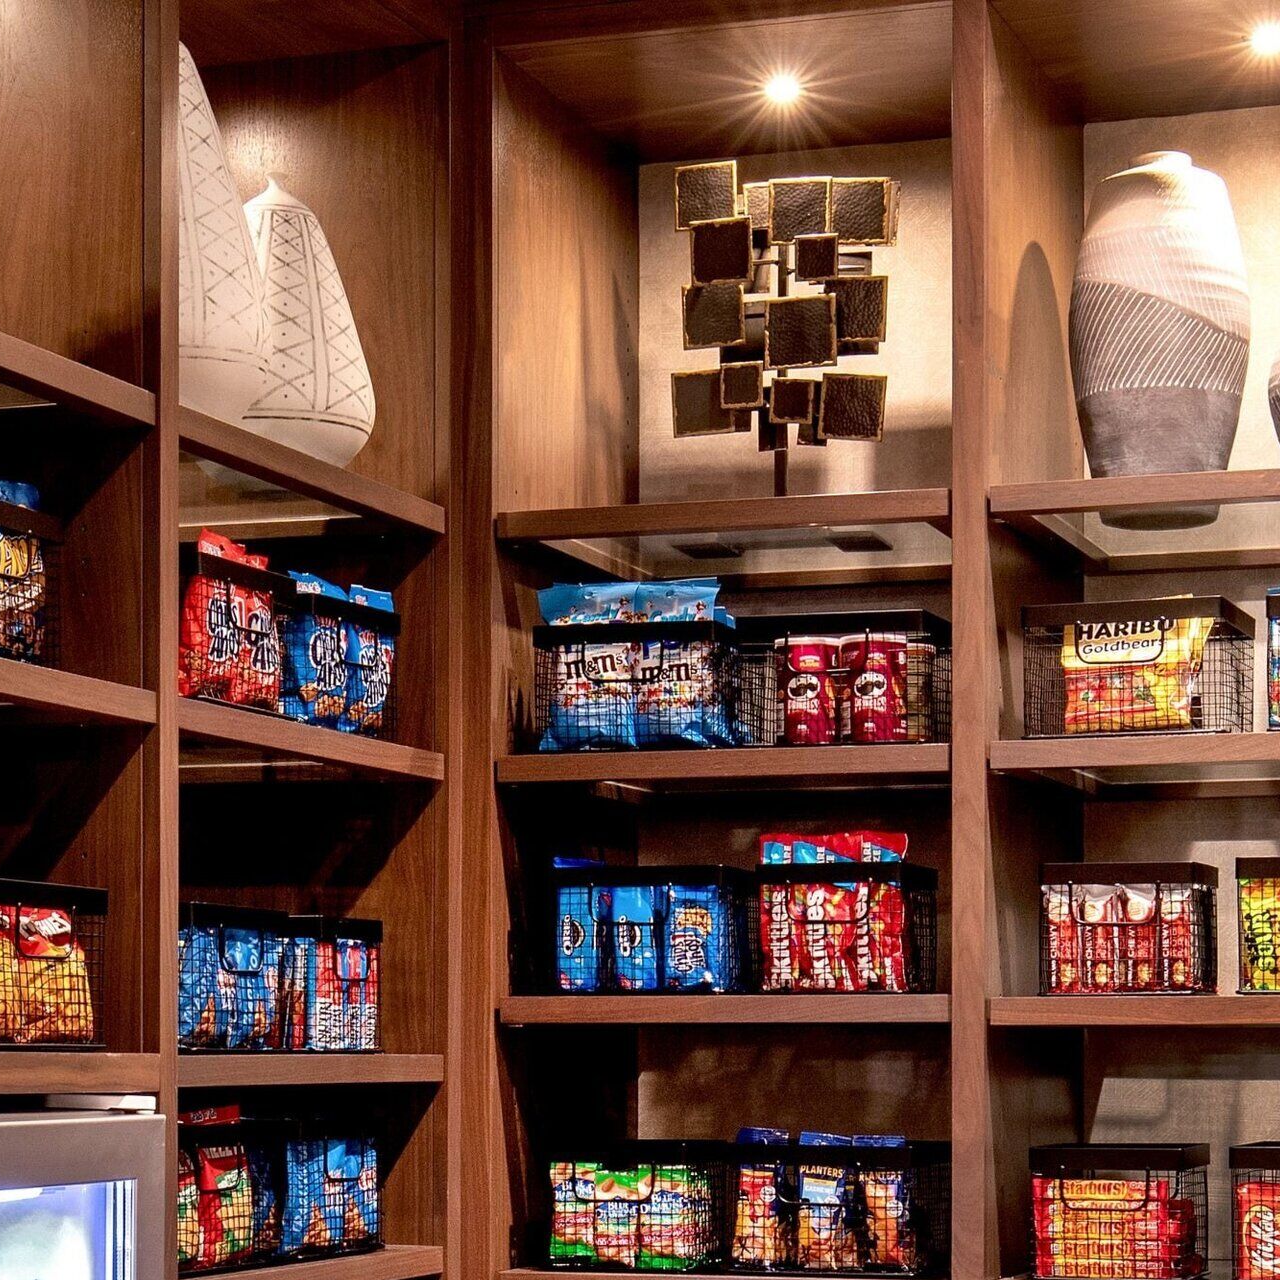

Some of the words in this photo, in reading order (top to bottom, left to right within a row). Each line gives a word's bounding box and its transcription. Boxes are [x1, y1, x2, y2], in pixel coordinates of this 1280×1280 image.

[1078, 619, 1175, 641] HARIBO
[1082, 637, 1165, 655] Goldbears
[800, 1165, 844, 1178] PLANTERS
